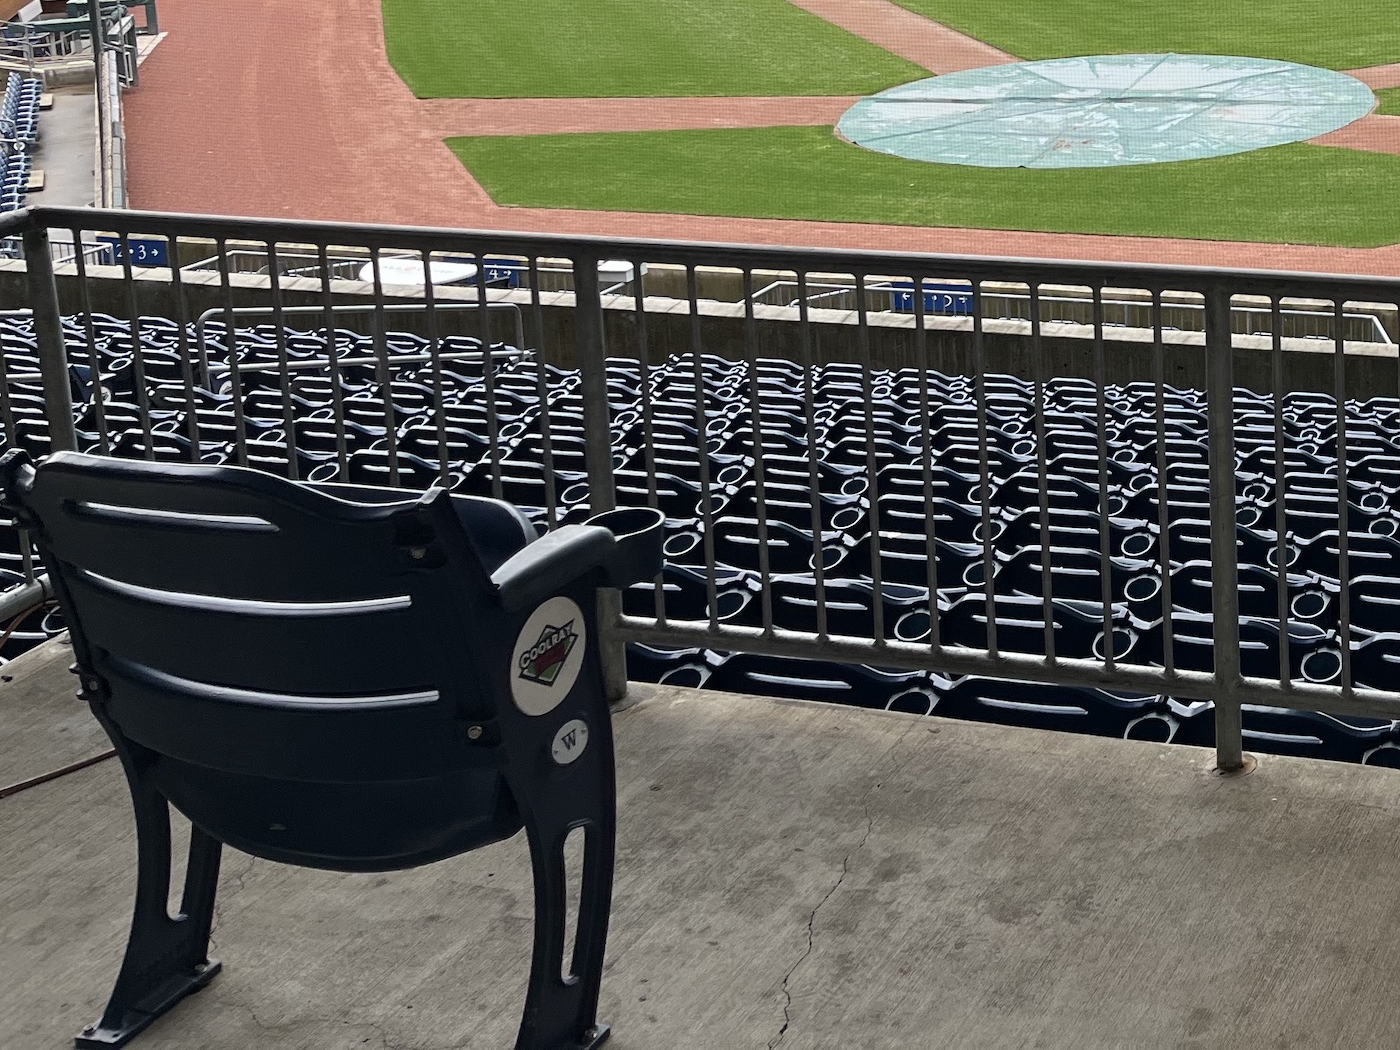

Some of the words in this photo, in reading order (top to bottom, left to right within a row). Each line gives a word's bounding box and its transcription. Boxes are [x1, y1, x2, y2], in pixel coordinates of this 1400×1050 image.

[138, 245, 147, 260] 3
[520, 622, 574, 668] COOLRAY
[561, 728, 577, 751] W
